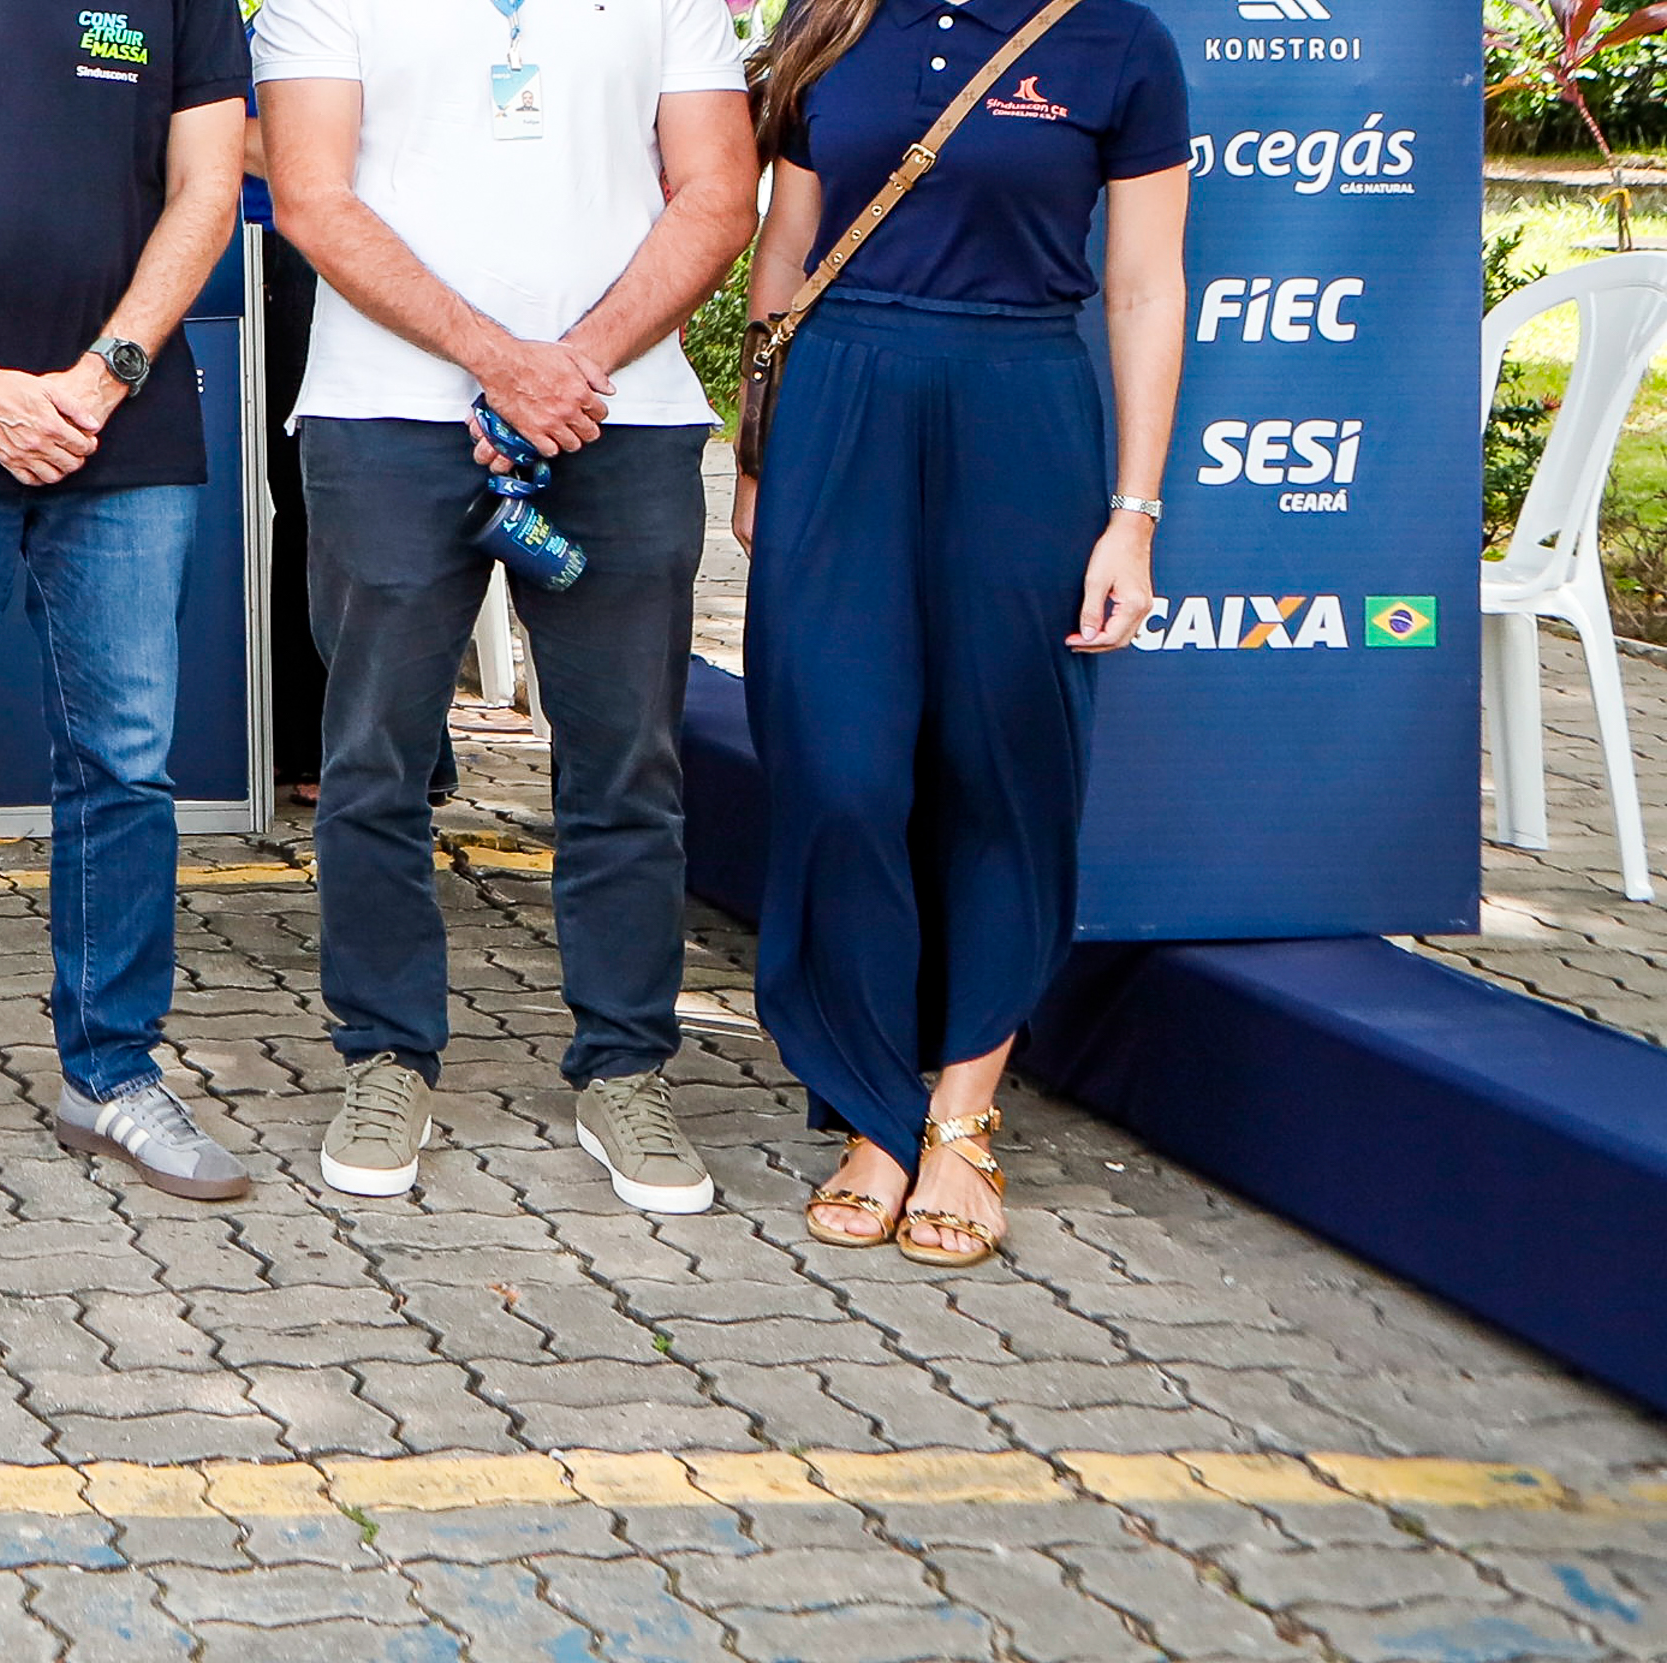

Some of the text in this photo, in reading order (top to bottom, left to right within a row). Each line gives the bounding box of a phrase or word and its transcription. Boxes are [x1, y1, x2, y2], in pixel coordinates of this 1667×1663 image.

[78, 10, 128, 30] CONS
[91, 25, 144, 48] TRUIR
[90, 41, 148, 65] MASSA
[1204, 37, 1362, 62] KONSTROI
[986, 98, 1049, 113] Sinduscon
[1222, 112, 1417, 196] cegás
[1339, 182, 1415, 195] GÁS NATURAL
[1278, 488, 1349, 513] CEARÁ
[1130, 594, 1350, 651] CAIXA
